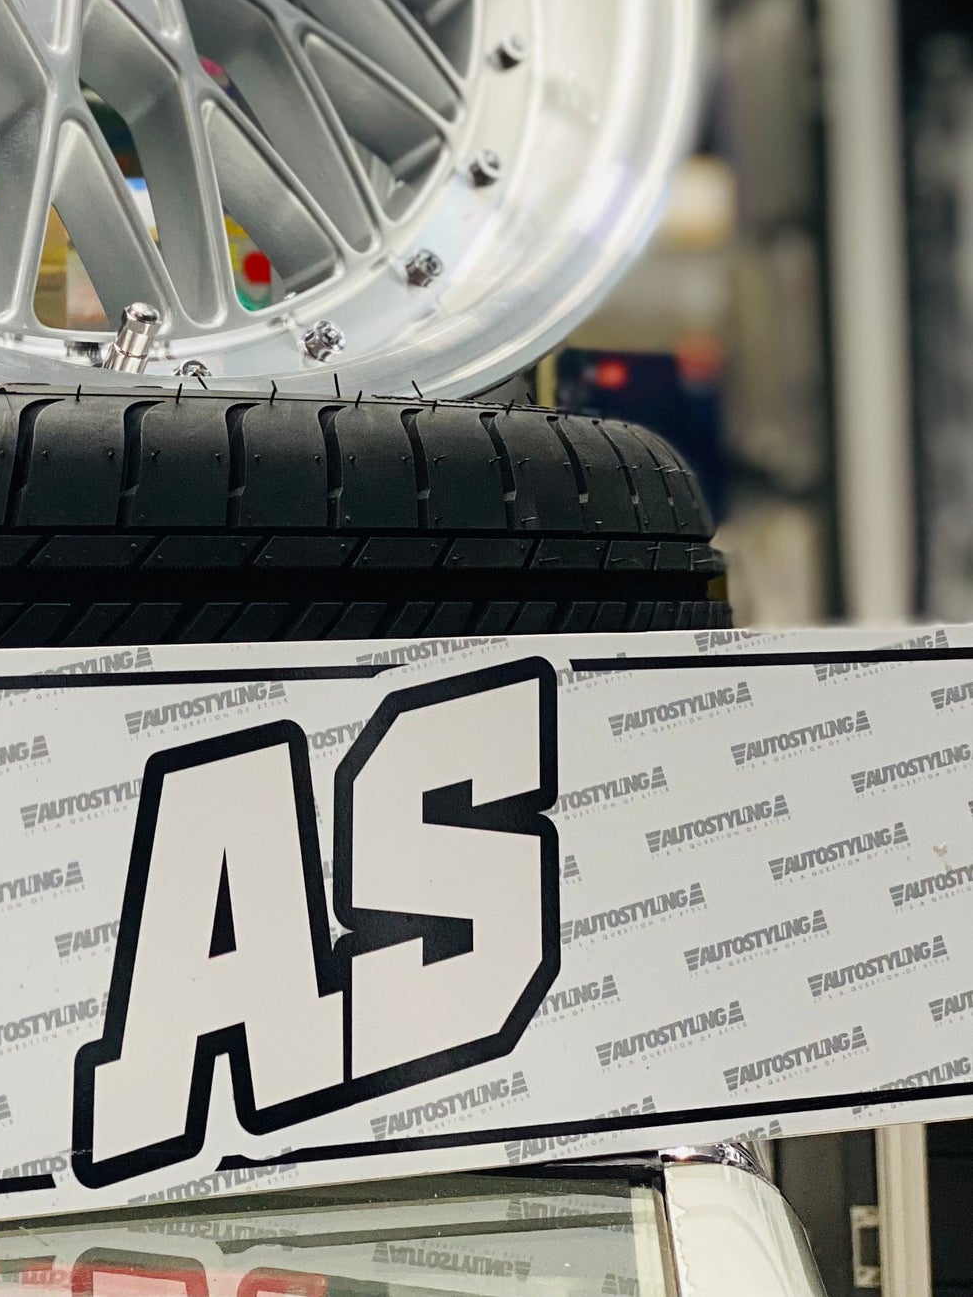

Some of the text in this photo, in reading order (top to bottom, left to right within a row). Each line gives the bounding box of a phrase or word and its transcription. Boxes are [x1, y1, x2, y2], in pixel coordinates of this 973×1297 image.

[141, 681, 270, 730] AUTOSTYLING
[624, 686, 737, 732] AUTOSTYLING
[745, 715, 856, 761] AUTOSTYLING
[865, 743, 972, 789] AUTOSTYLING
[661, 799, 775, 848] AUTOSTYLING
[783, 827, 894, 876] AUTOSTYLING
[73, 656, 561, 1189] AS
[573, 888, 690, 940] AUTOSTYLING
[699, 915, 813, 966] AUTOSTYLING
[822, 941, 933, 992] AUTOSTYLING
[612, 1006, 729, 1061] AUTOSTYLING
[739, 1031, 853, 1086] AUTOSTYLING
[387, 1077, 512, 1135] AUTOSTYLING
